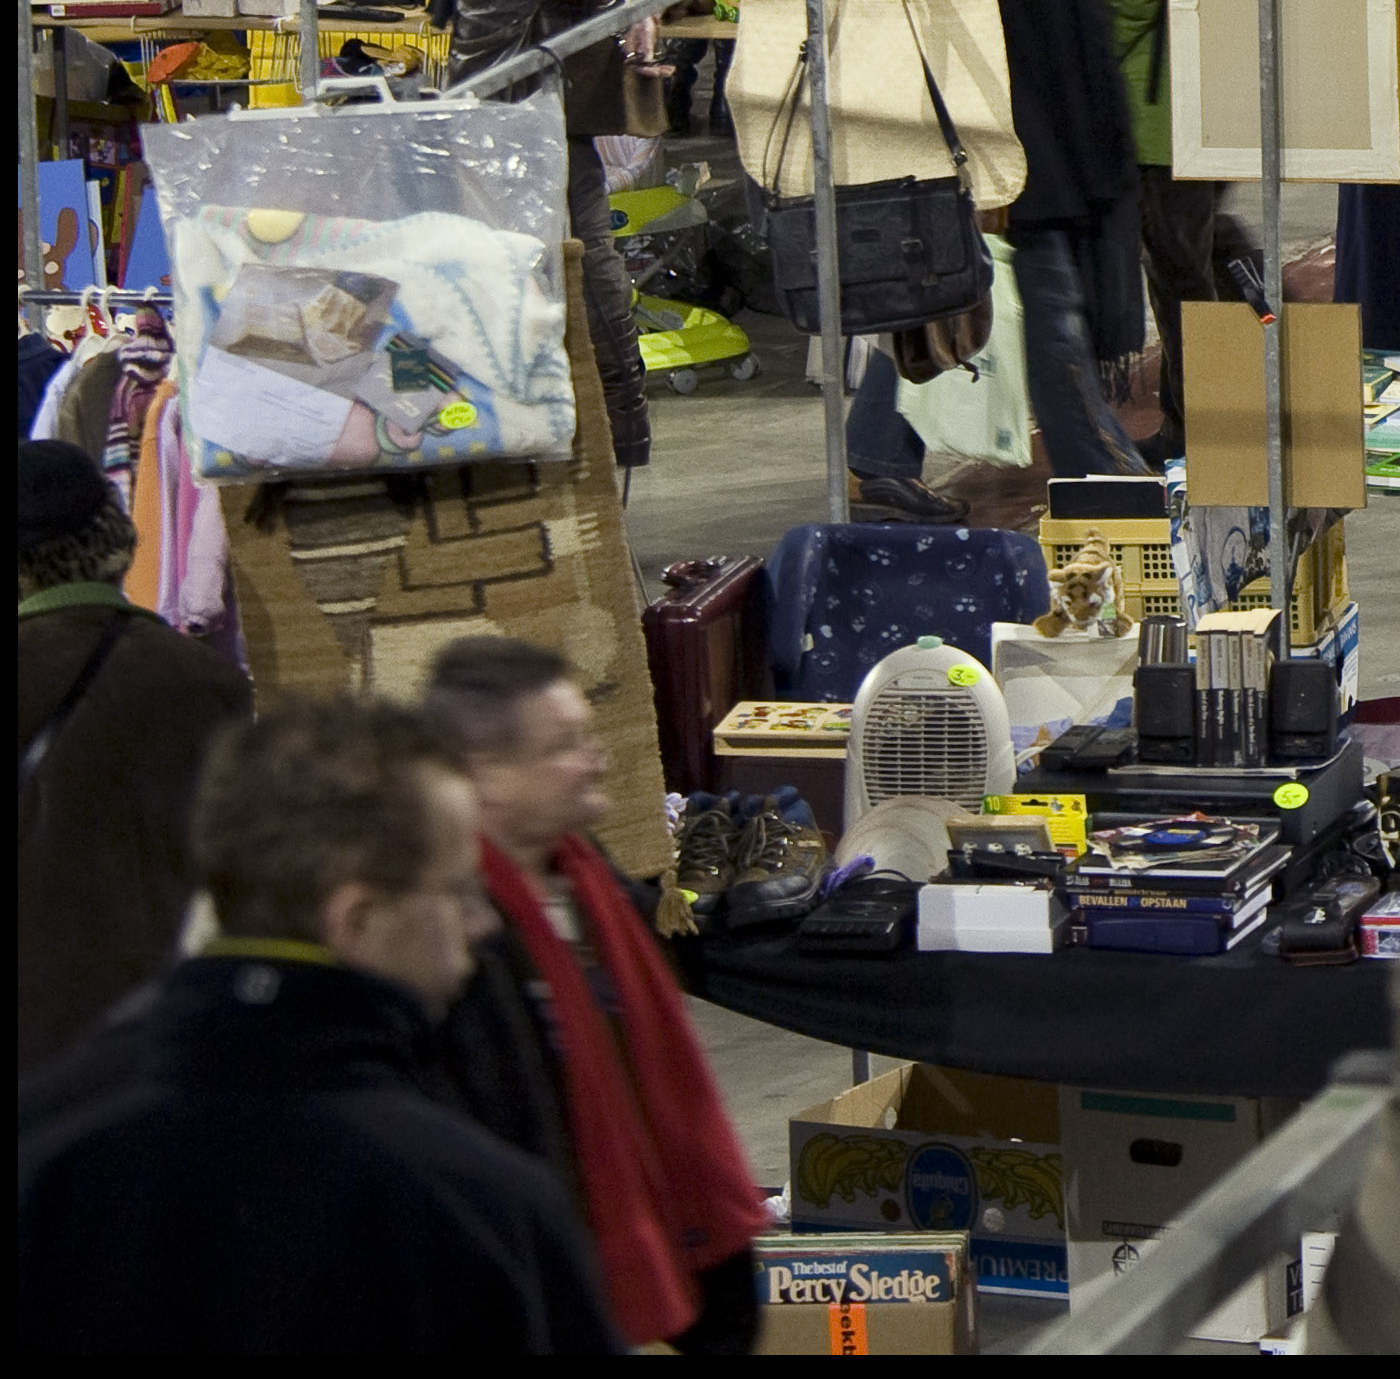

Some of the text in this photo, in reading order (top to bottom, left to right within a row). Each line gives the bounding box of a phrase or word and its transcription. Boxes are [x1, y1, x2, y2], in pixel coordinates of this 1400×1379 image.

[986, 796, 1000, 811] 10
[1078, 895, 1128, 907] BEVALLEN
[1140, 897, 1187, 909] OPSTAAN
[792, 1260, 848, 1275] The best of
[768, 1263, 941, 1304] Percy Sledge
